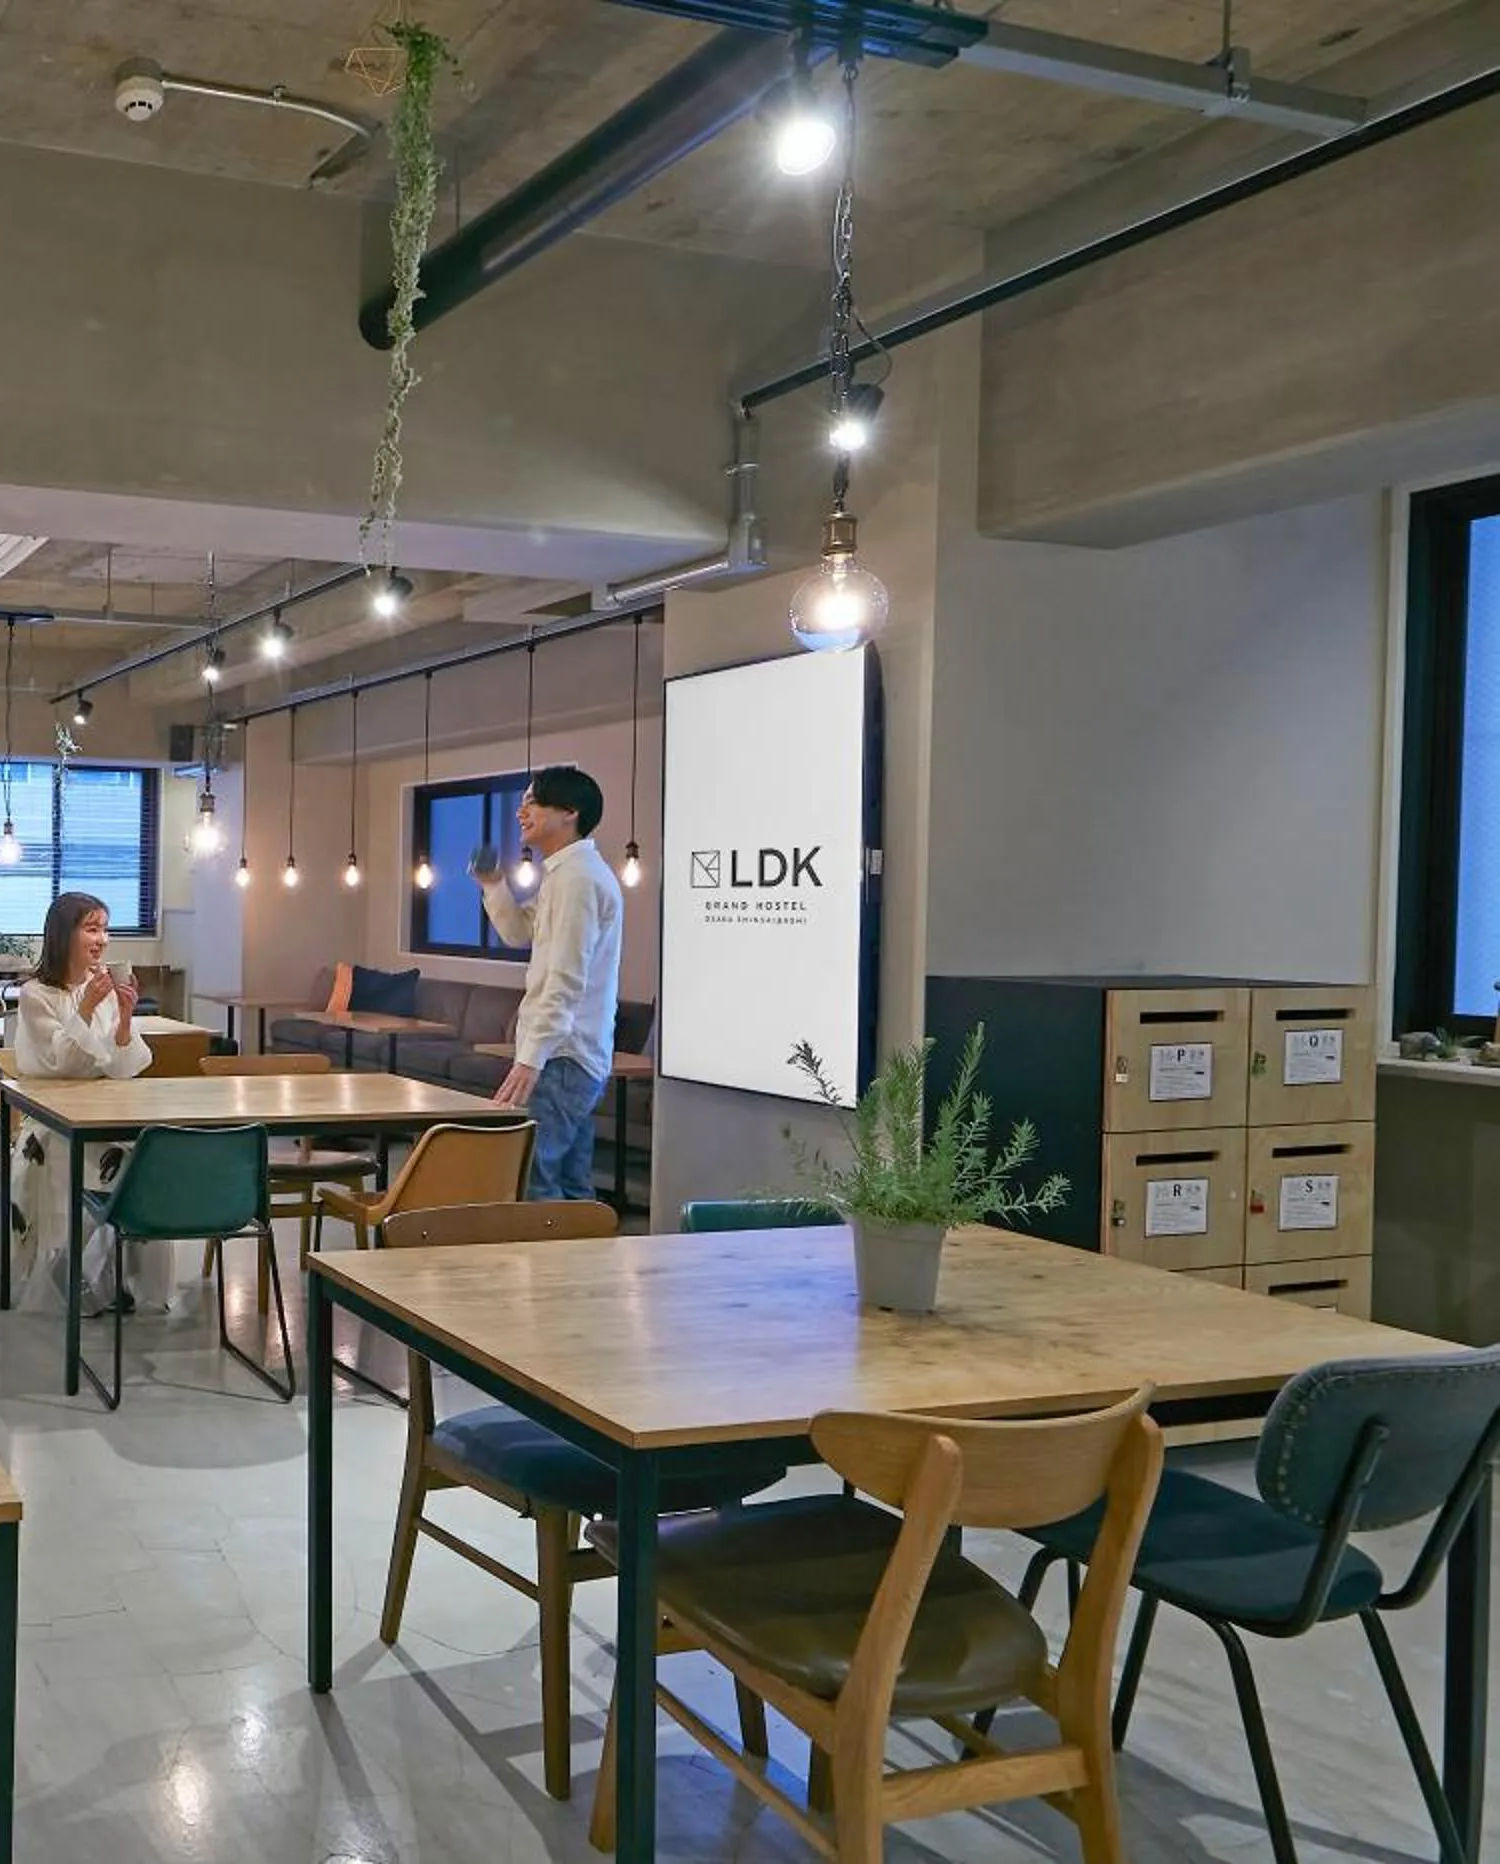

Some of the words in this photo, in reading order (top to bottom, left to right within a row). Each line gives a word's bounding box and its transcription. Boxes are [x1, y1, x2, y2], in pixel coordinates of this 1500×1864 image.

[731, 846, 823, 888] LDK
[705, 901, 749, 911] GRAND
[755, 901, 807, 911] HOSTEL
[1177, 1049, 1185, 1062] P
[1173, 1184, 1182, 1197] R
[1305, 1180, 1313, 1193] S
